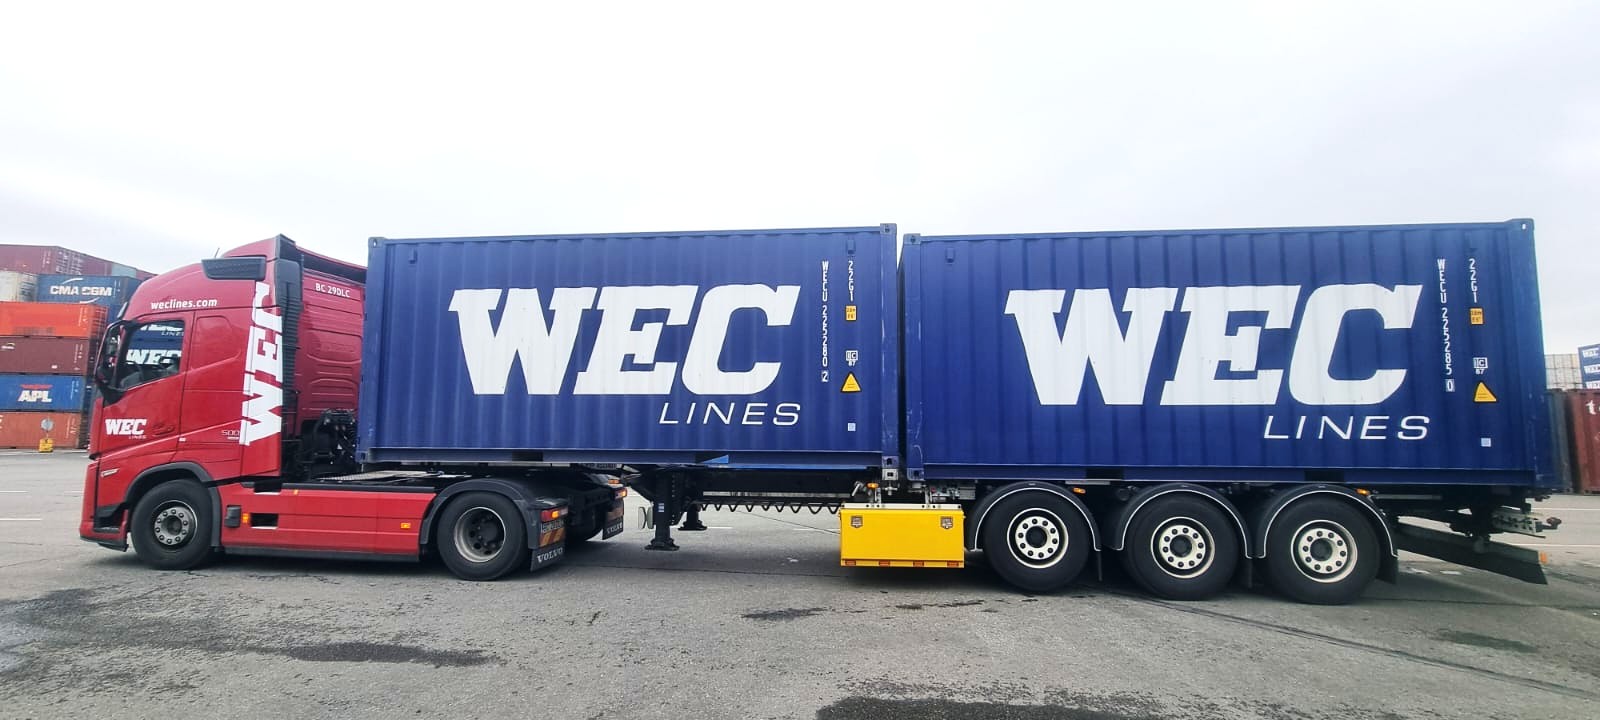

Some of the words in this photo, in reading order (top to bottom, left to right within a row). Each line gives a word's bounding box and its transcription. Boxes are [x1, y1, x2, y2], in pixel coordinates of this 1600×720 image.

[50, 285, 79, 295] CMA
[81, 286, 112, 297] CGM
[315, 283, 326, 293] BC
[327, 285, 351, 298] 29DLC
[821, 260, 829, 302] WECU
[847, 260, 855, 302] 22G1
[1437, 259, 1447, 303] WECU
[1468, 258, 1478, 303] 22G1
[151, 298, 218, 310] weclines.com
[448, 284, 801, 395] WEC
[821, 305, 829, 367] 225280
[1004, 283, 1423, 406] WEC
[1441, 307, 1453, 376] 225285
[18, 390, 53, 403] APL
[105, 418, 147, 435] WEC
[659, 402, 801, 426] LINES
[1263, 415, 1430, 440] LINES
[537, 547, 563, 563] VOLVO
